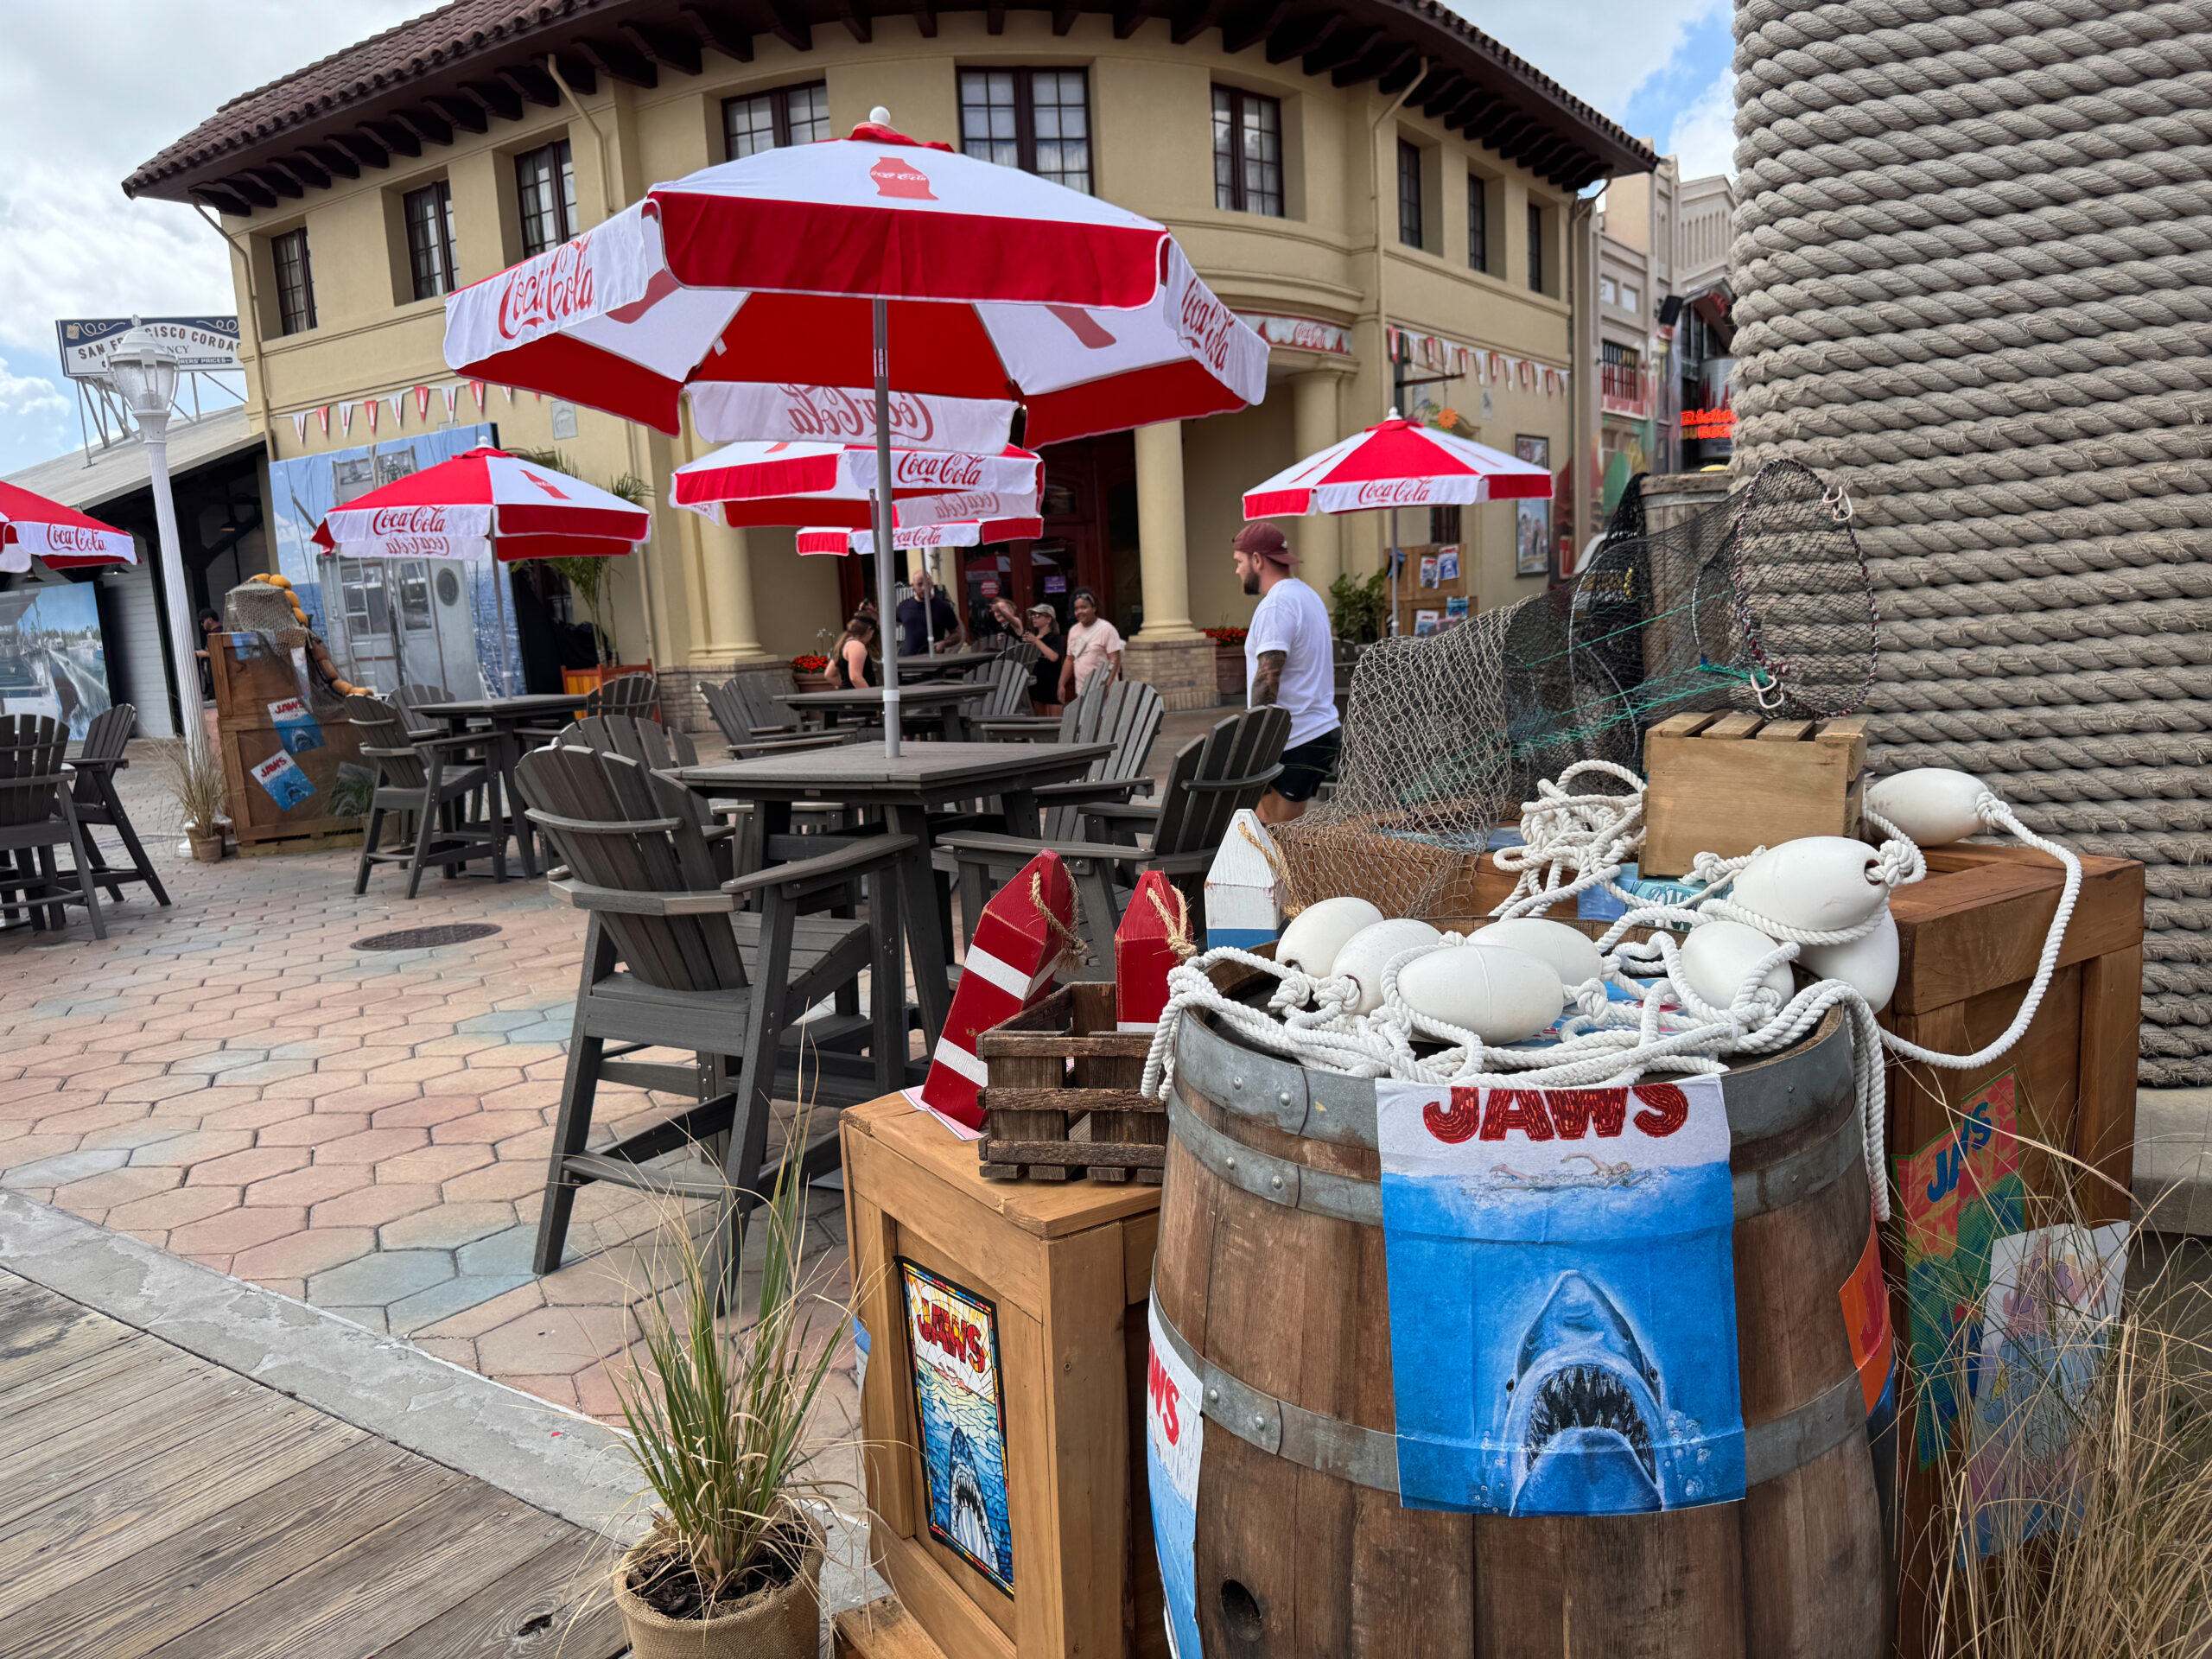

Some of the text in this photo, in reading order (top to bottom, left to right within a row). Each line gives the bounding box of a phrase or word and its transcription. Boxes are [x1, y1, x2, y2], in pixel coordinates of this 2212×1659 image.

[78, 344, 105, 360] SAN
[898, 451, 987, 486] Coca-Cola
[1358, 477, 1434, 505] Coca-Cola
[373, 506, 448, 536] Coca-Cola
[261, 757, 288, 778] JAWS
[1422, 1082, 1689, 1144] JAWS
[917, 1296, 986, 1374] JAWS
